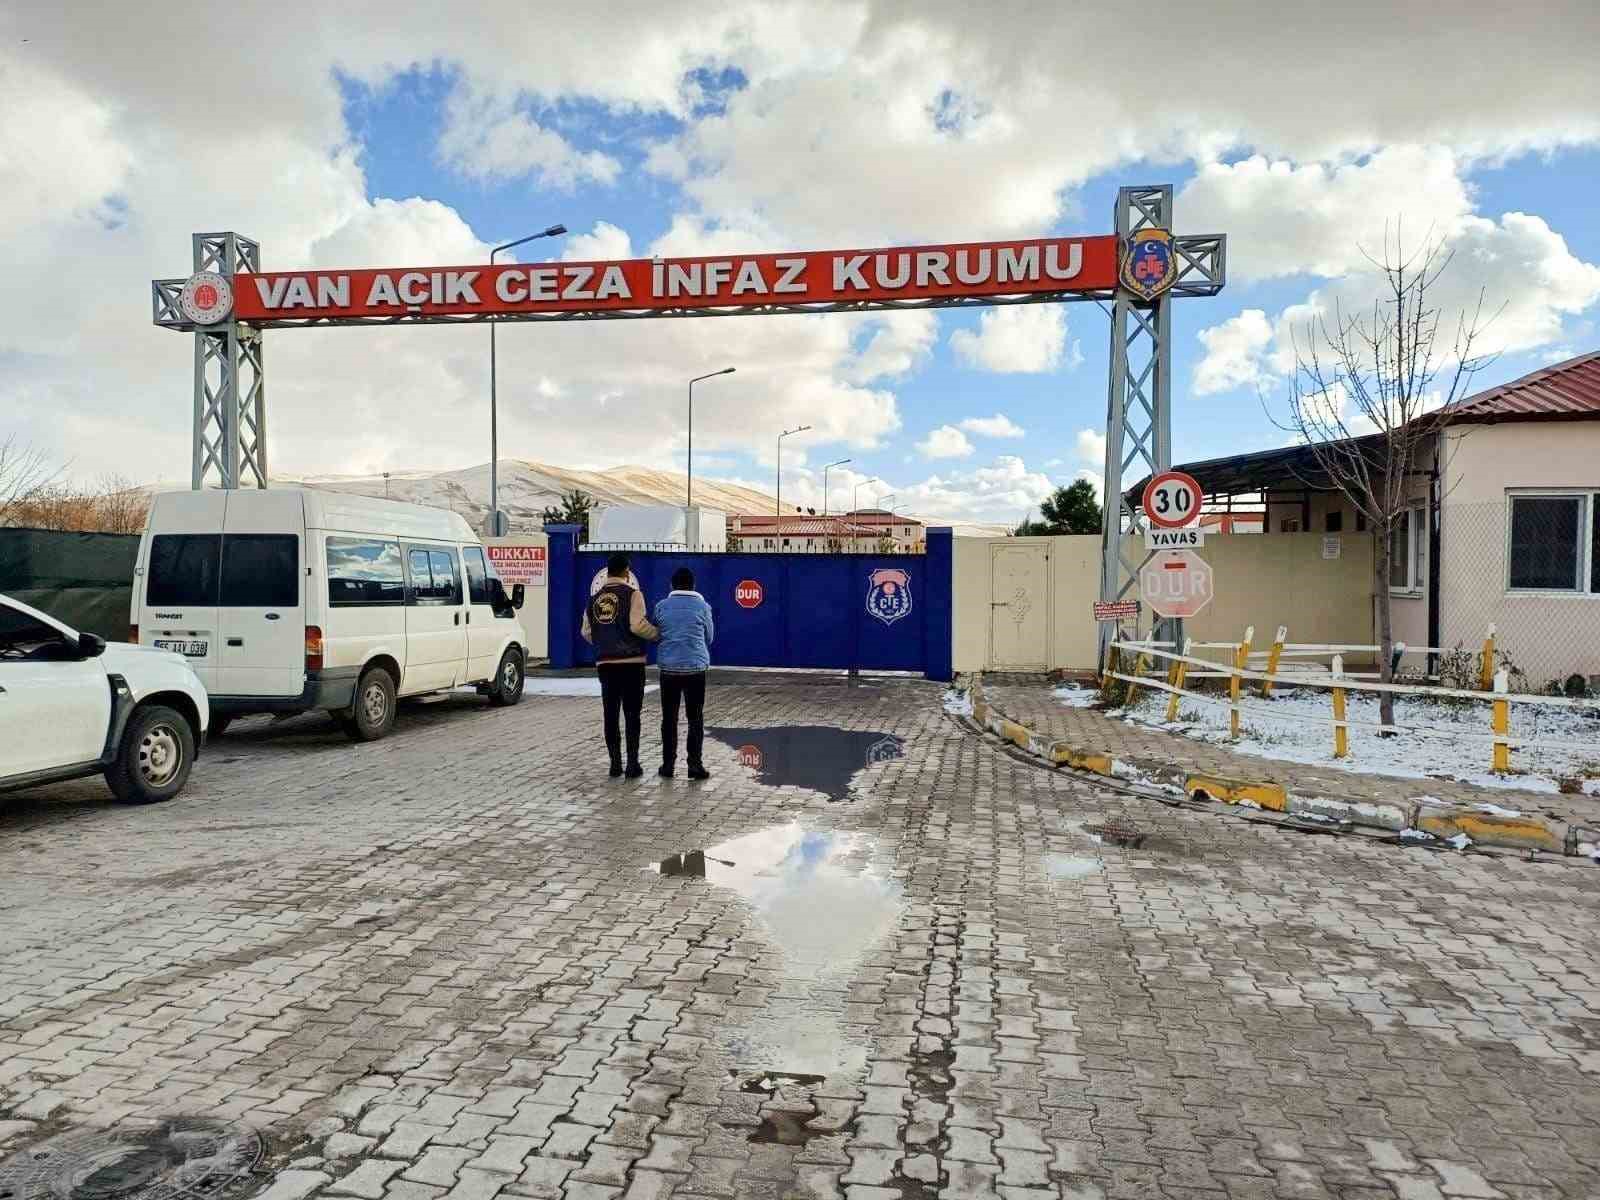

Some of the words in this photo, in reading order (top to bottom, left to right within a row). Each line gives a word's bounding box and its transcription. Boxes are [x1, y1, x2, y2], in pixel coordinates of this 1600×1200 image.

[255, 275, 351, 309] VAN
[367, 270, 481, 313] AÇIK
[495, 265, 633, 303] CEZA
[652, 254, 808, 298] İNFAZ
[832, 242, 1084, 290] KURUMU
[1155, 488, 1191, 513] 30
[1151, 531, 1198, 546] YAVAŞ
[492, 548, 542, 560] DİKKAT!
[737, 588, 760, 600] DUR
[1146, 571, 1206, 597] DUR
